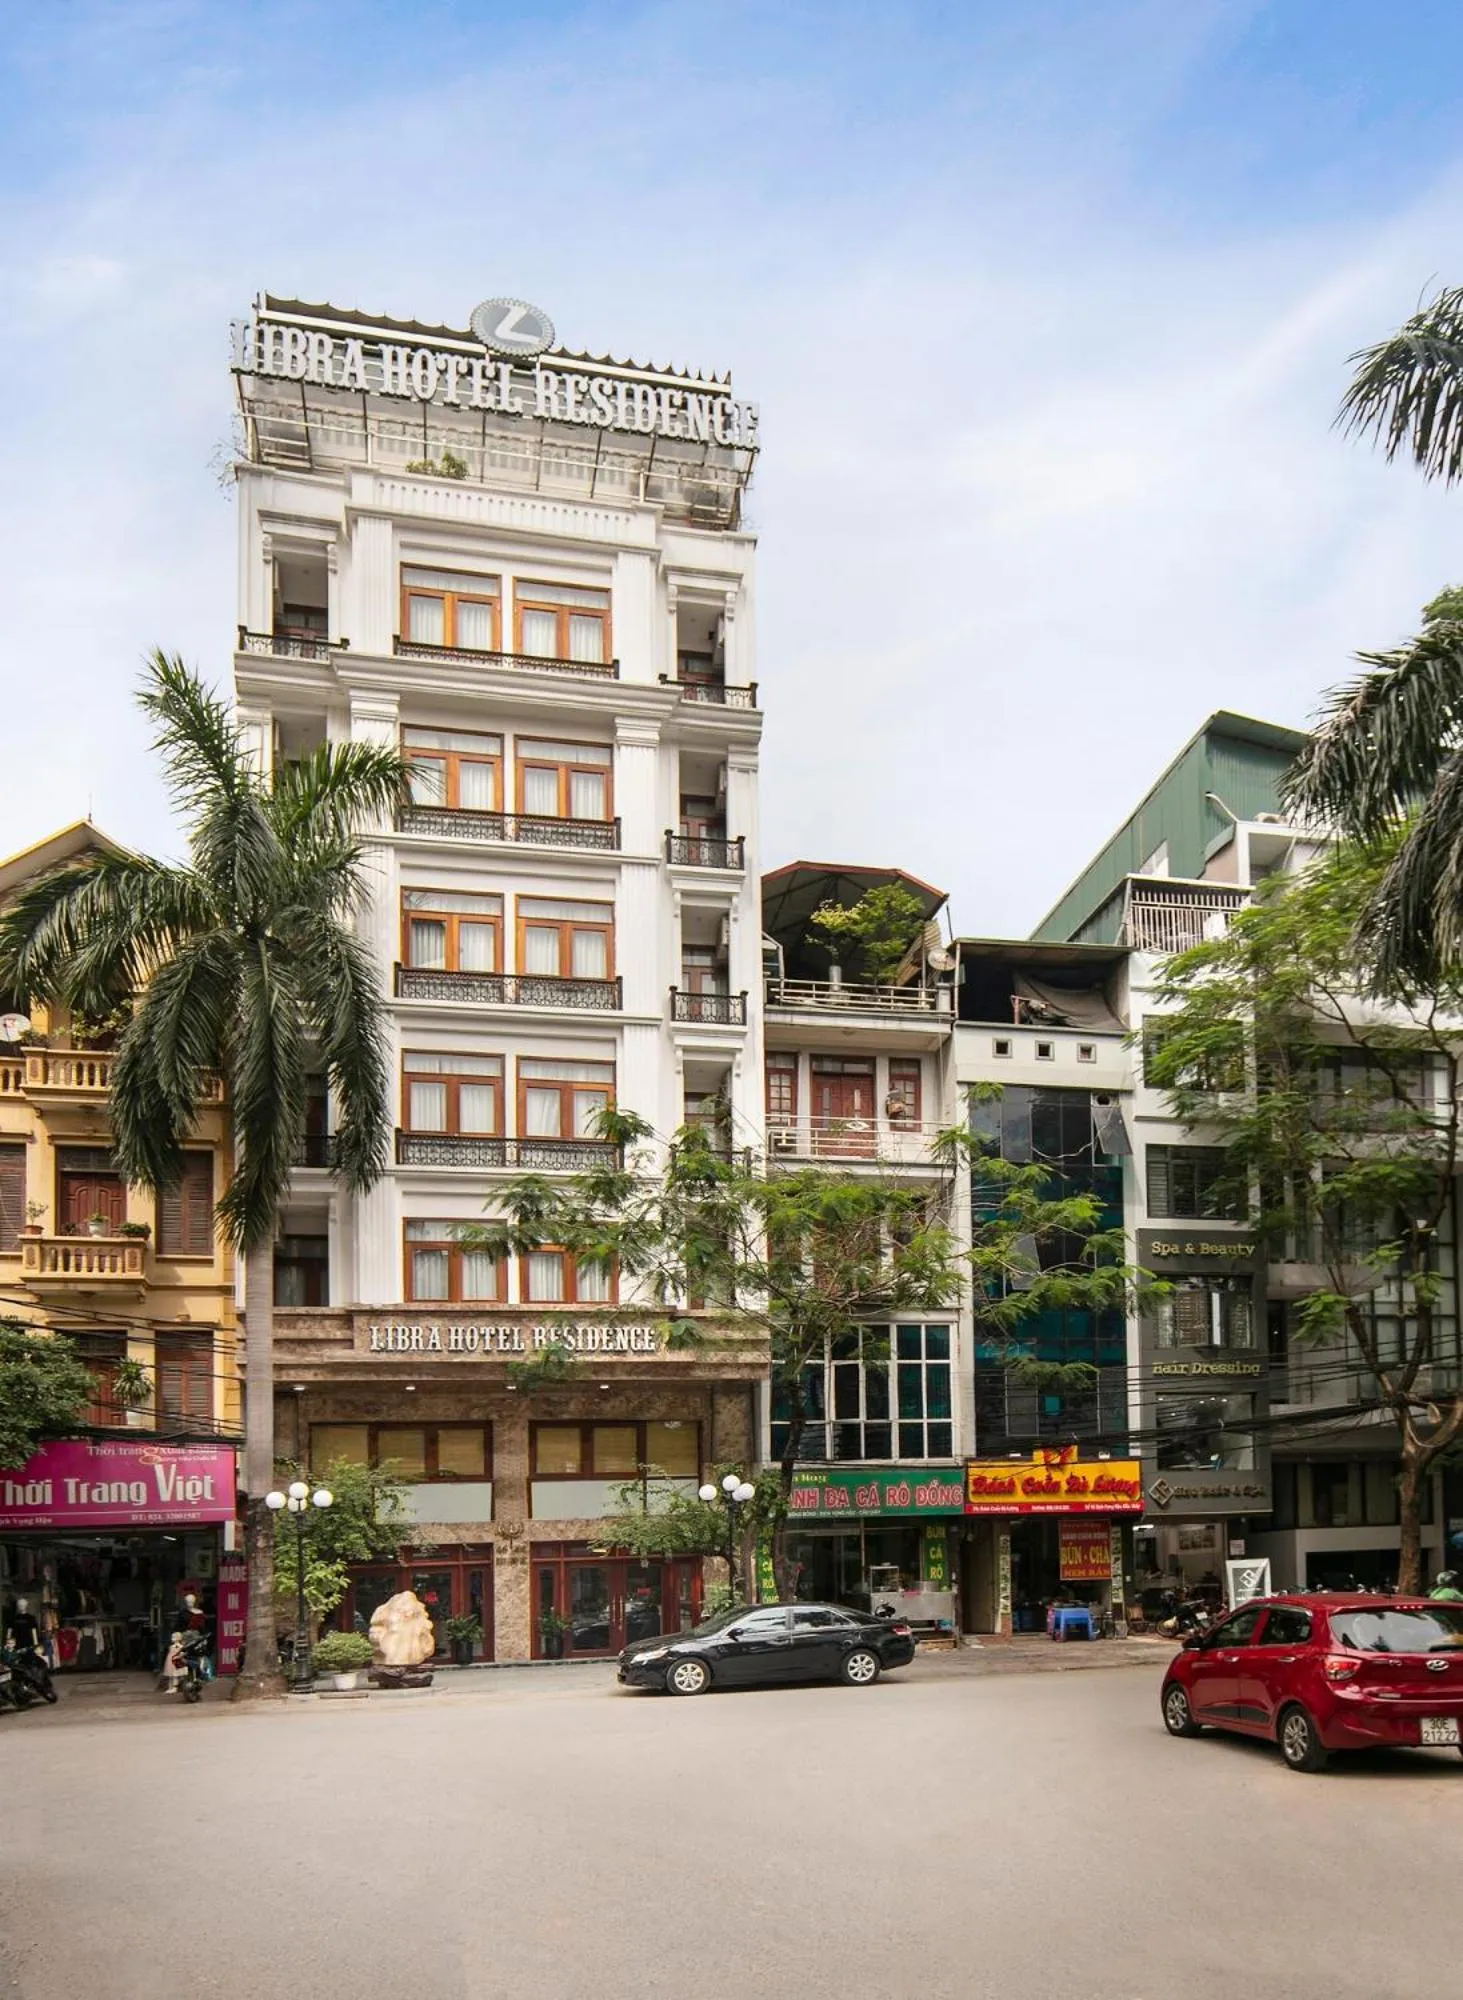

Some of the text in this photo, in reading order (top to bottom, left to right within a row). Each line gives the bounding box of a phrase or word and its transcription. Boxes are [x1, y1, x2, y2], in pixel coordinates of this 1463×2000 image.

[229, 319, 761, 450] LIBRA HOTEL RESIDENCE
[1151, 1241, 1255, 1257] Spa & Beauty
[370, 1326, 655, 1350] LIBRA HOTEL RESIDENCE
[1152, 1360, 1260, 1376] Hair Dressing
[63, 1478, 147, 1506] Trang
[155, 1463, 215, 1505] Việt
[824, 1486, 850, 1508] ĐA
[855, 1480, 881, 1508] CÁ
[886, 1480, 911, 1507] RÔ
[218, 1566, 248, 1582] MADE
[227, 1593, 239, 1610] IN
[1430, 1718, 1449, 1730] 30E
